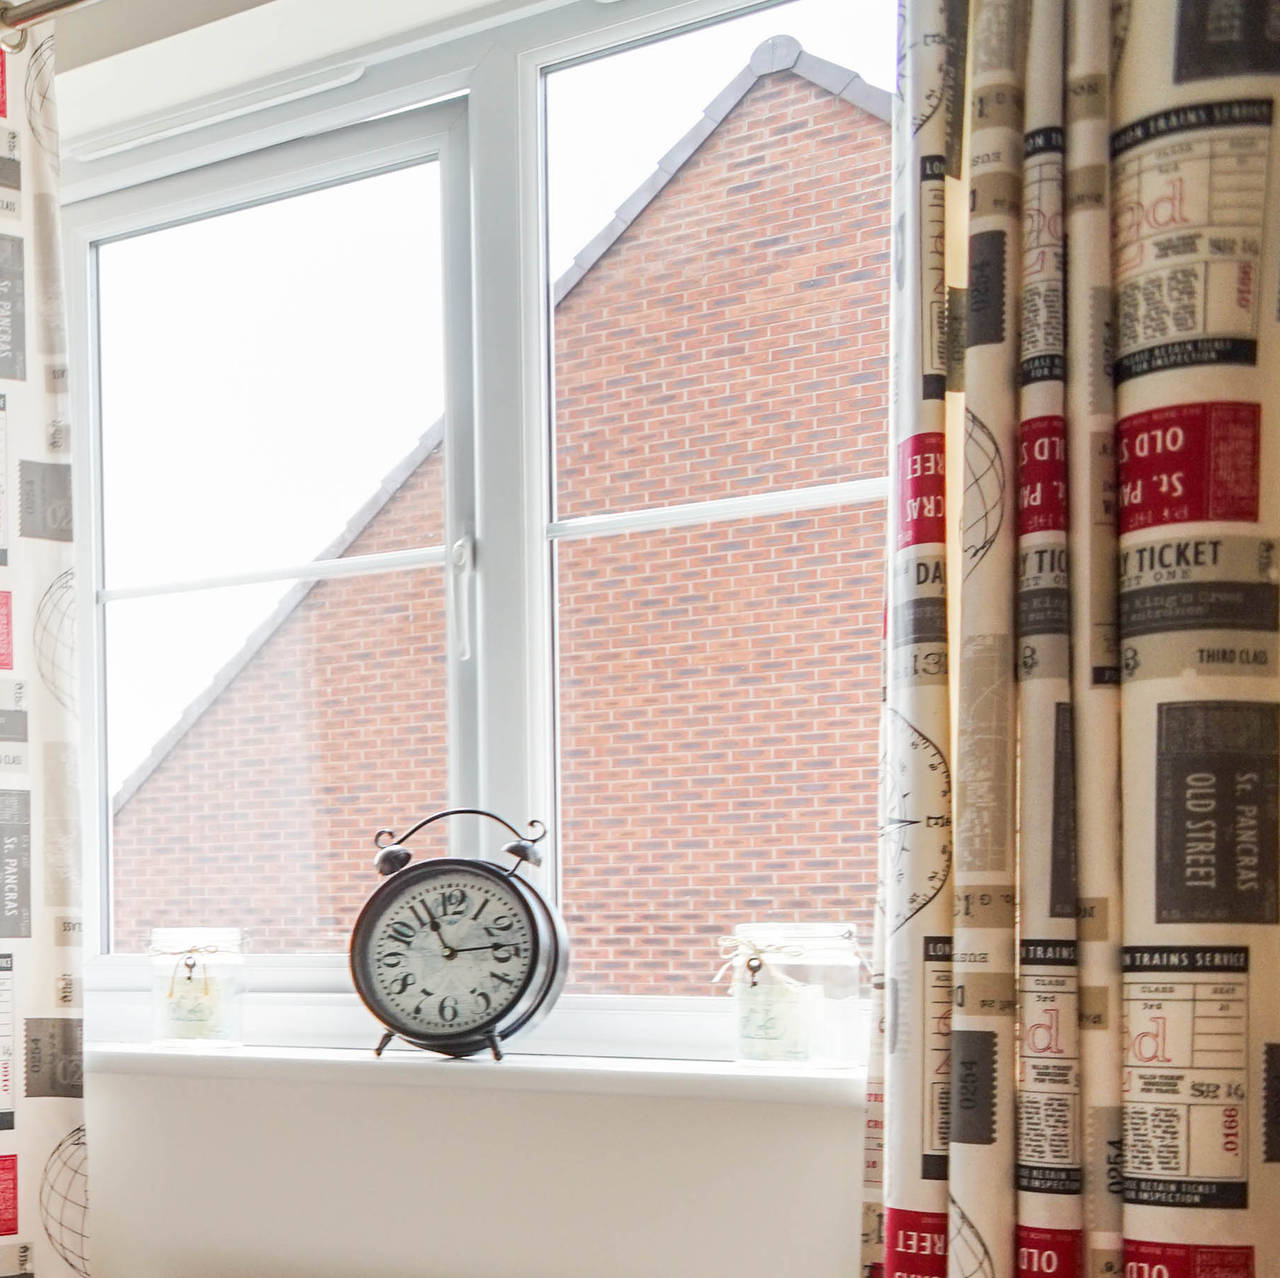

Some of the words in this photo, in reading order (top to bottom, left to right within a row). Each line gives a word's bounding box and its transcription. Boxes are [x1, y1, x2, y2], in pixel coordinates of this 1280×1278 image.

[1138, 541, 1222, 569] TICKET
[1198, 650, 1237, 664] THIRD
[1184, 818, 1217, 889] STREET
[1235, 805, 1259, 891] PANCRAS
[4, 858, 19, 916] PANCRAS
[439, 889, 467, 917] 12
[387, 921, 416, 946] 10
[483, 915, 514, 937] 2
[382, 951, 406, 968] 9
[1136, 951, 1190, 968] TRAINS
[1195, 952, 1246, 967] SERVICE
[390, 973, 416, 995] 8
[414, 988, 434, 1015] 7
[439, 995, 458, 1022] 6
[470, 988, 491, 1015] 5
